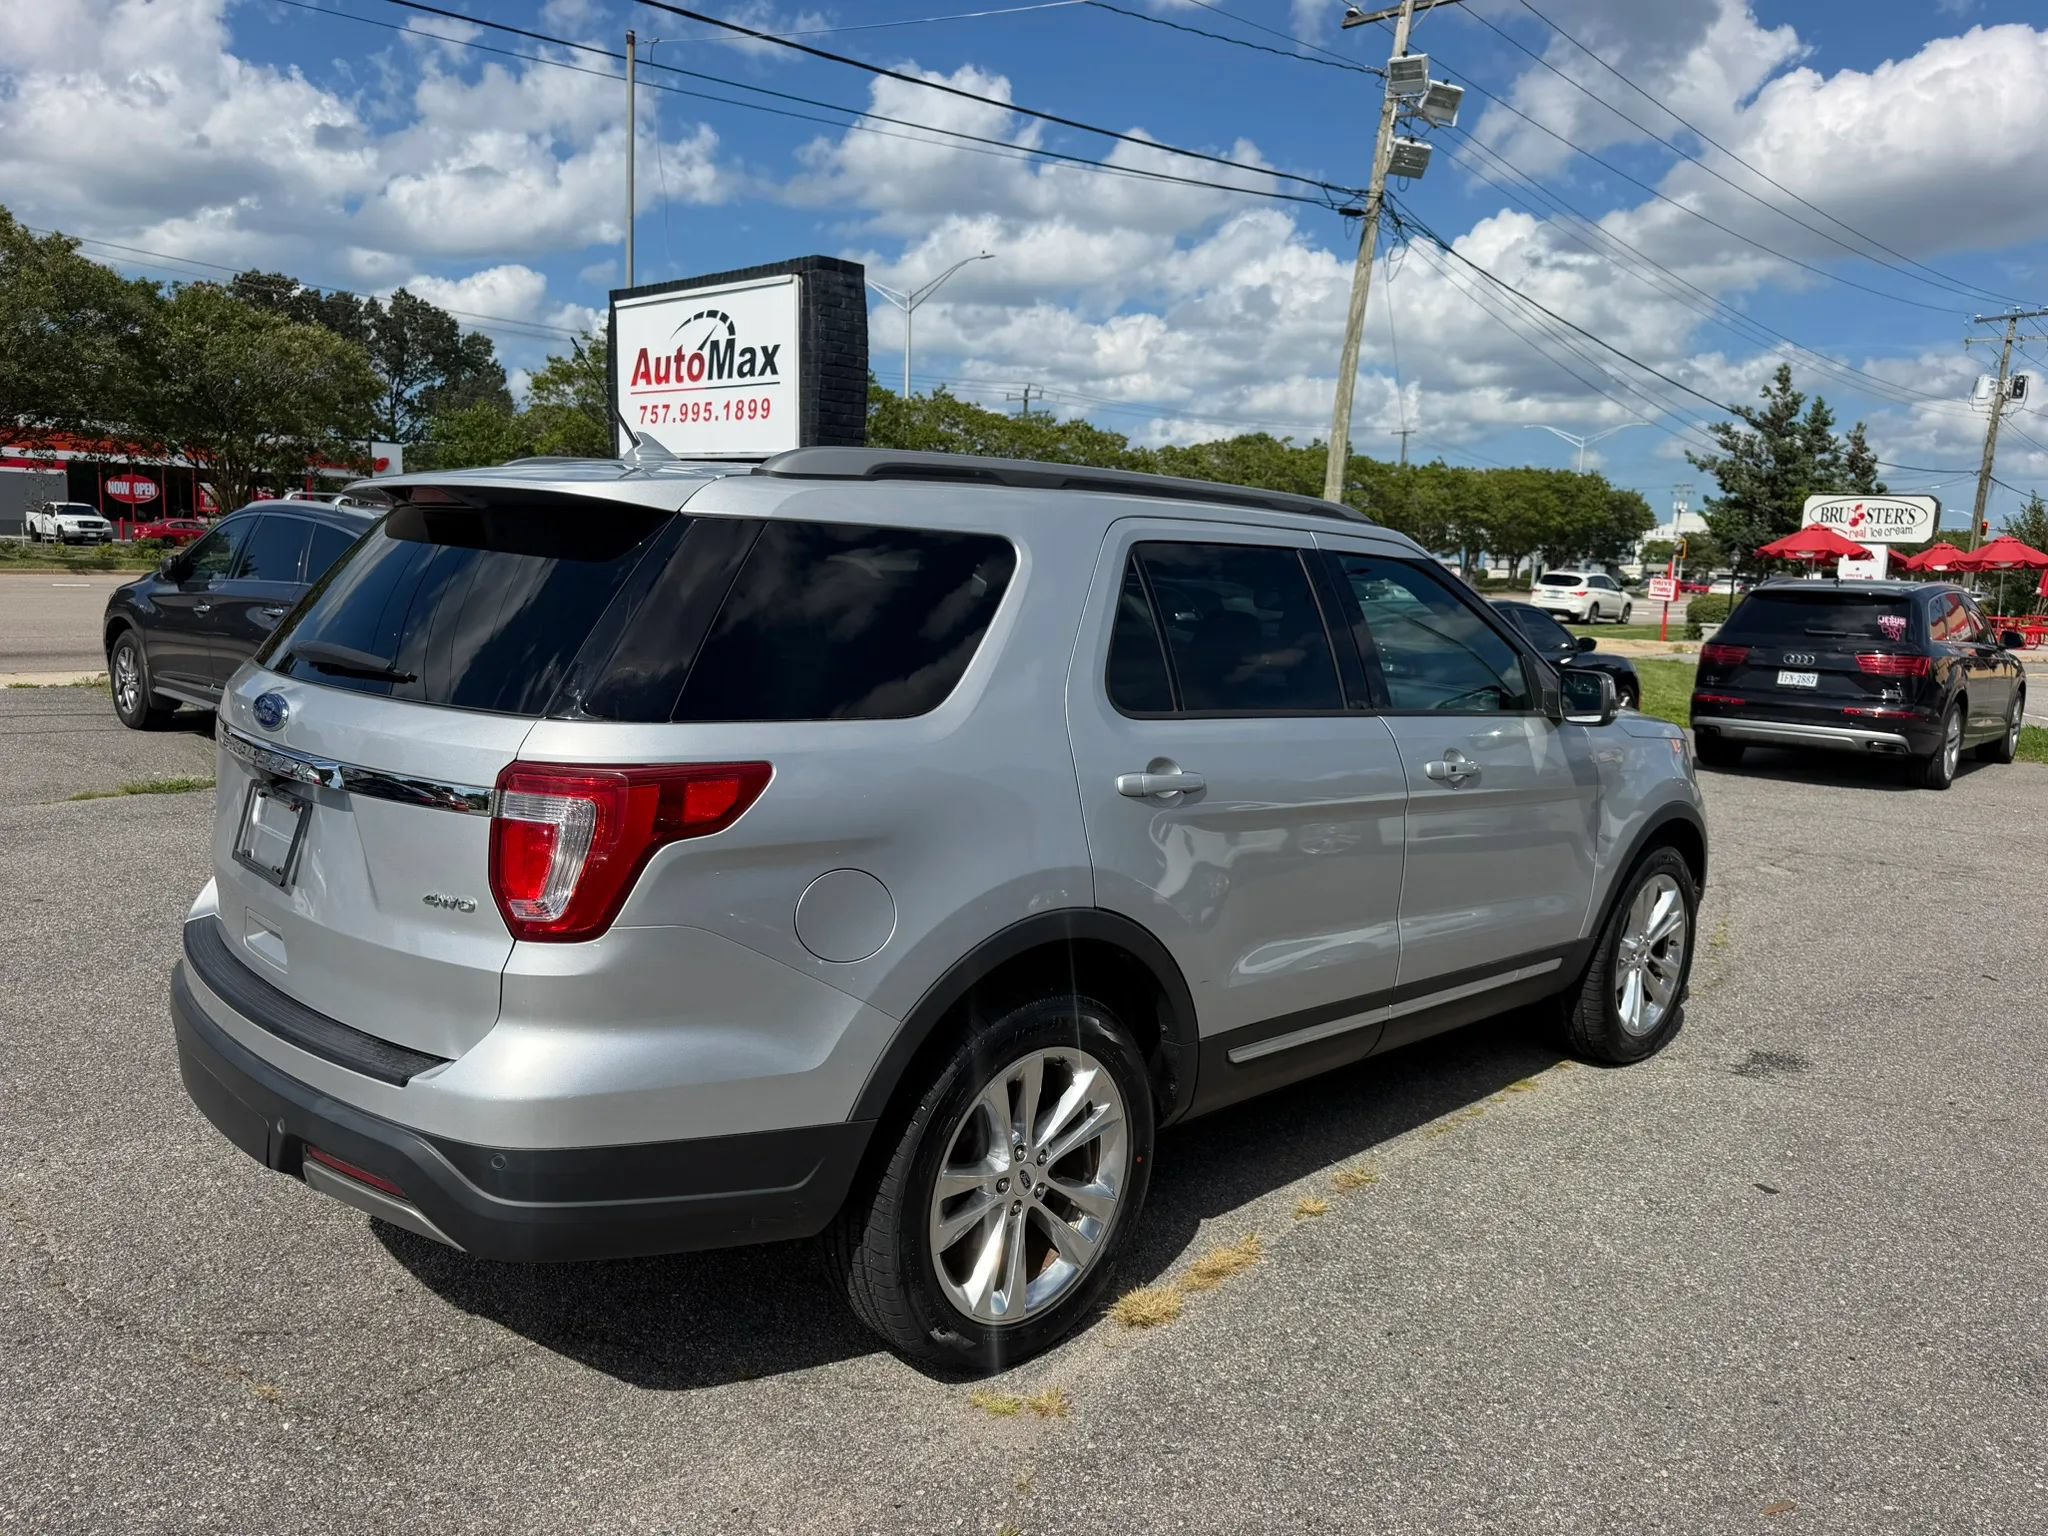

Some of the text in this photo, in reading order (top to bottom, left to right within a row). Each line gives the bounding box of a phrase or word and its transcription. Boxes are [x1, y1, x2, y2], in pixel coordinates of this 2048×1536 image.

[630, 338, 781, 387] AutoMax
[639, 398, 771, 425] 757.995.1899
[107, 481, 156, 496] NOW OPEN
[1849, 526, 1866, 539] real
[1884, 526, 1913, 537] cream
[422, 893, 477, 913] 4WD
